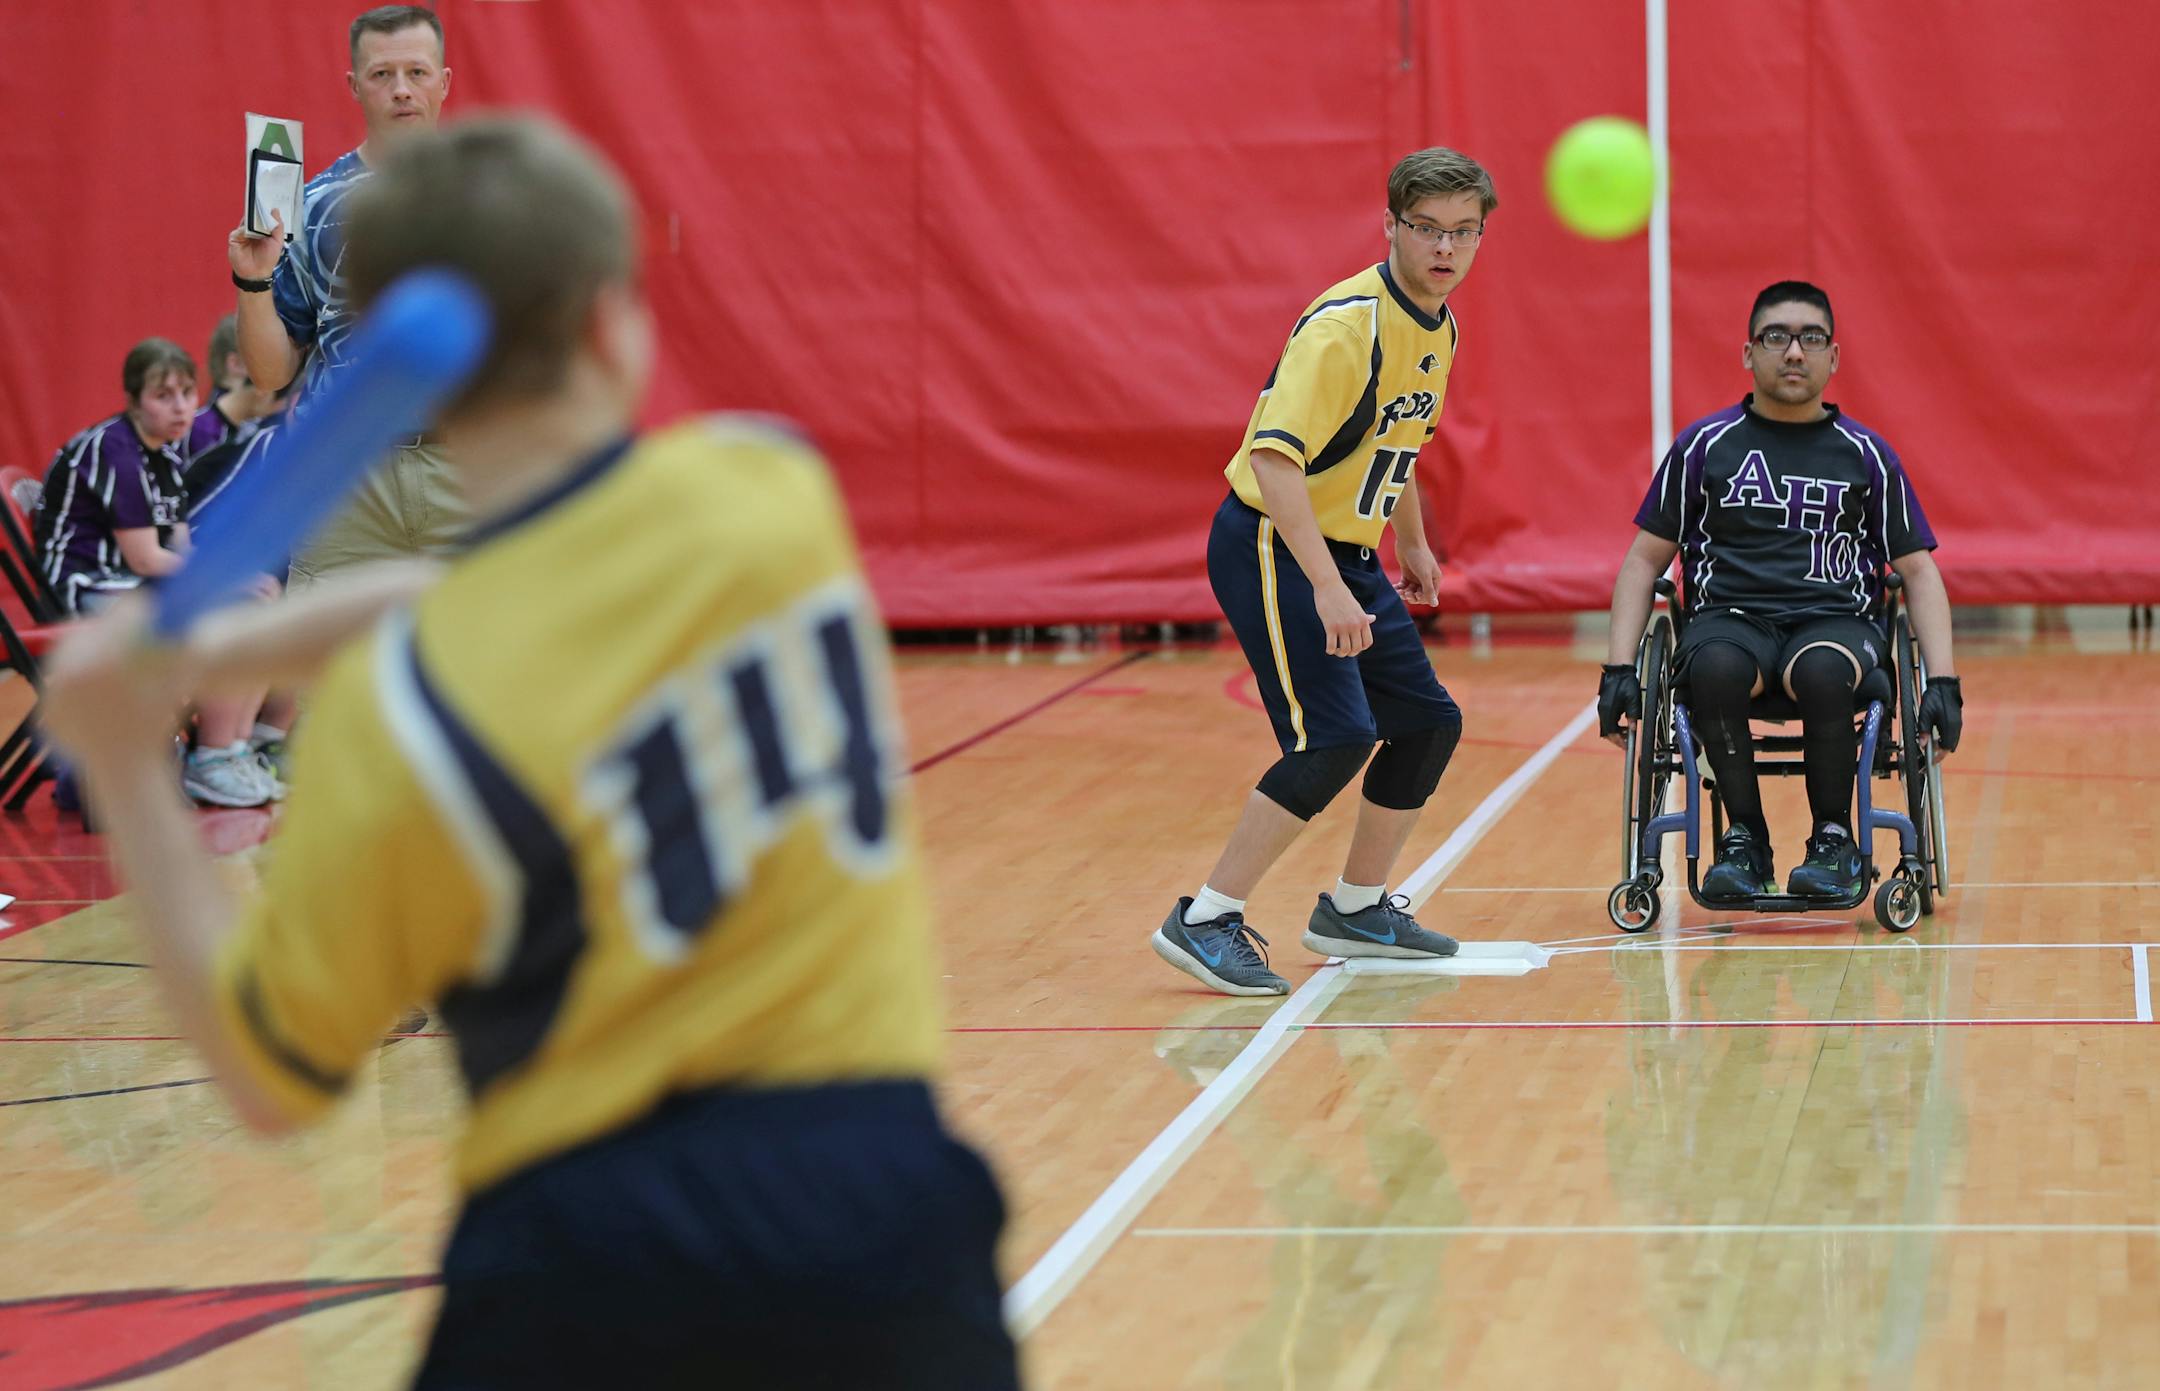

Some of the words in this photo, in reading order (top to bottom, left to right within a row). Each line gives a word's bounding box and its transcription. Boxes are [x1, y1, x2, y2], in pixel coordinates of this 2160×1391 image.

[1720, 450, 1851, 532] AH
[1803, 530, 1854, 584] 10
[584, 590, 902, 956] 14
